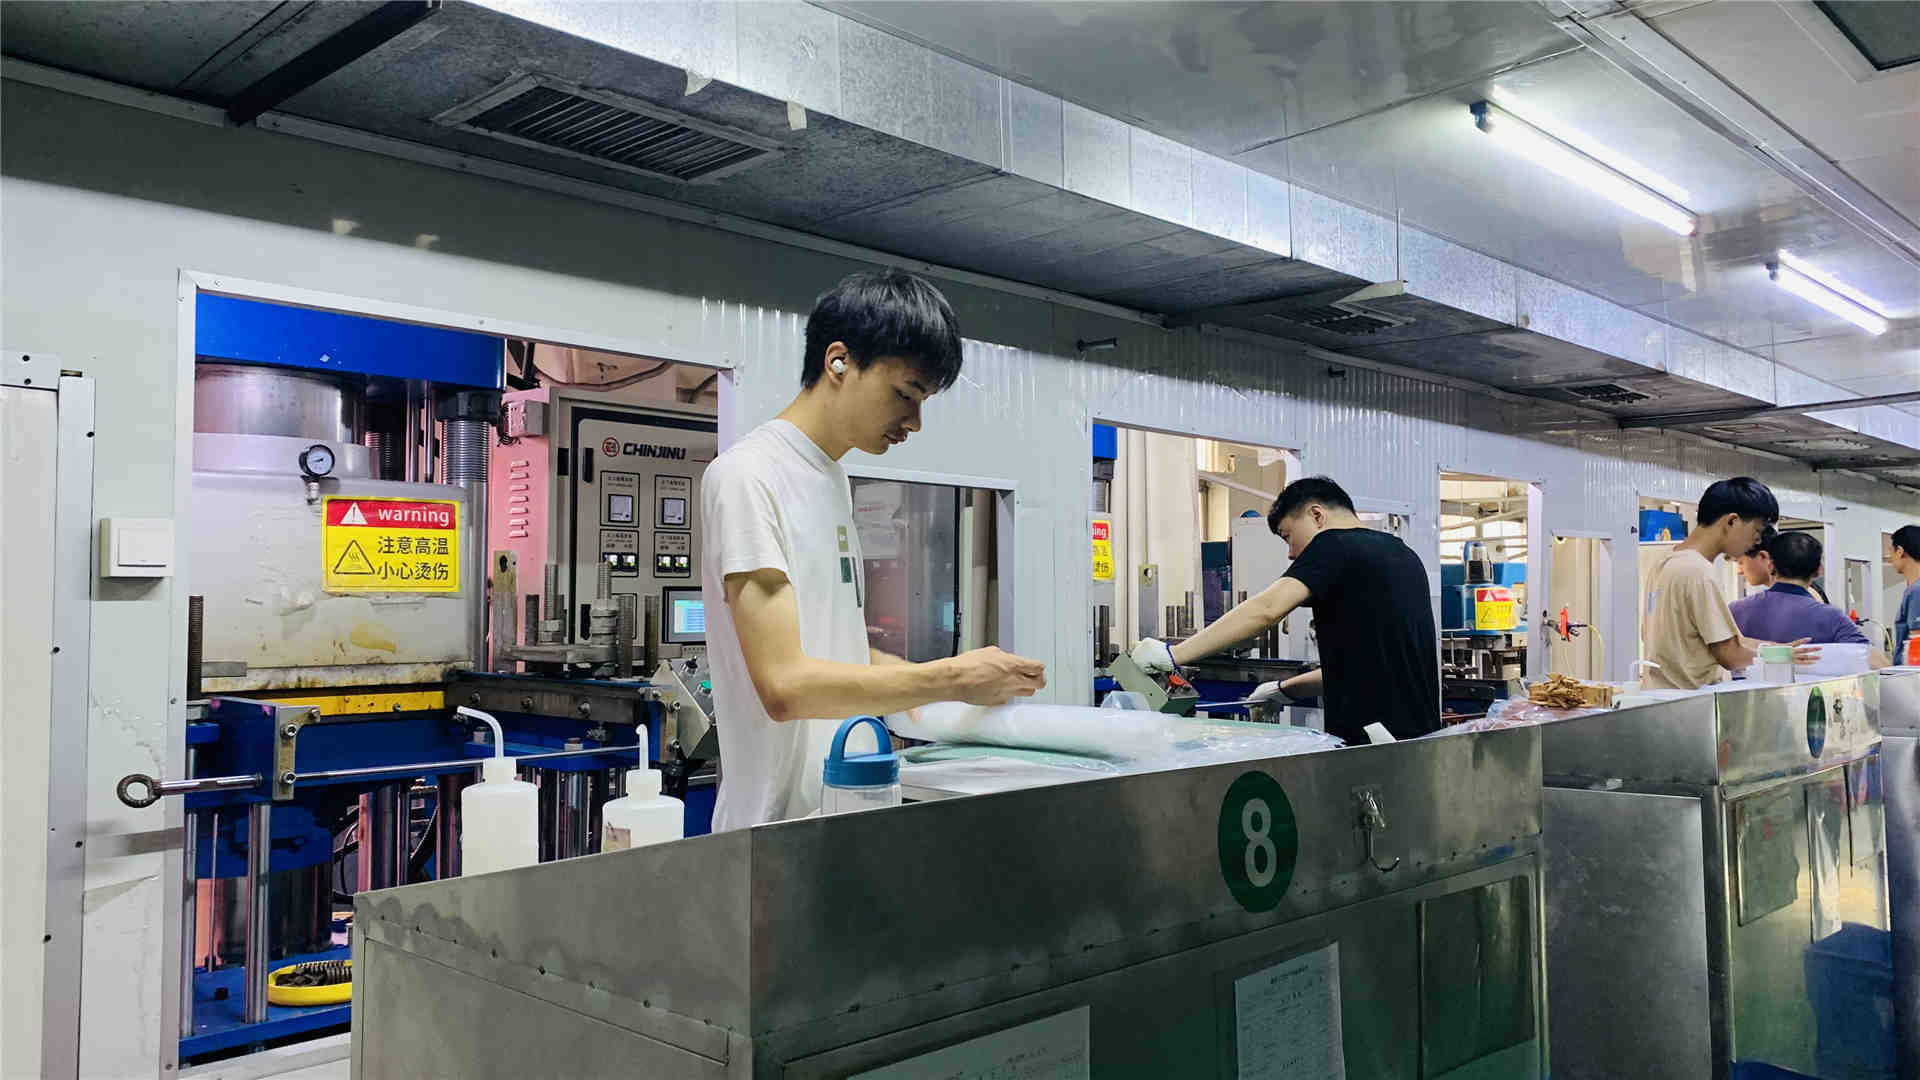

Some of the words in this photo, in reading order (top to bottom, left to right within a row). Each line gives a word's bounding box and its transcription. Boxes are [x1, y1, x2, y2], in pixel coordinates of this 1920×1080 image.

[378, 507, 449, 527] warning
[378, 536, 449, 555] 注意高温
[377, 561, 449, 580] 小心烫伤
[1242, 798, 1277, 887] 8
